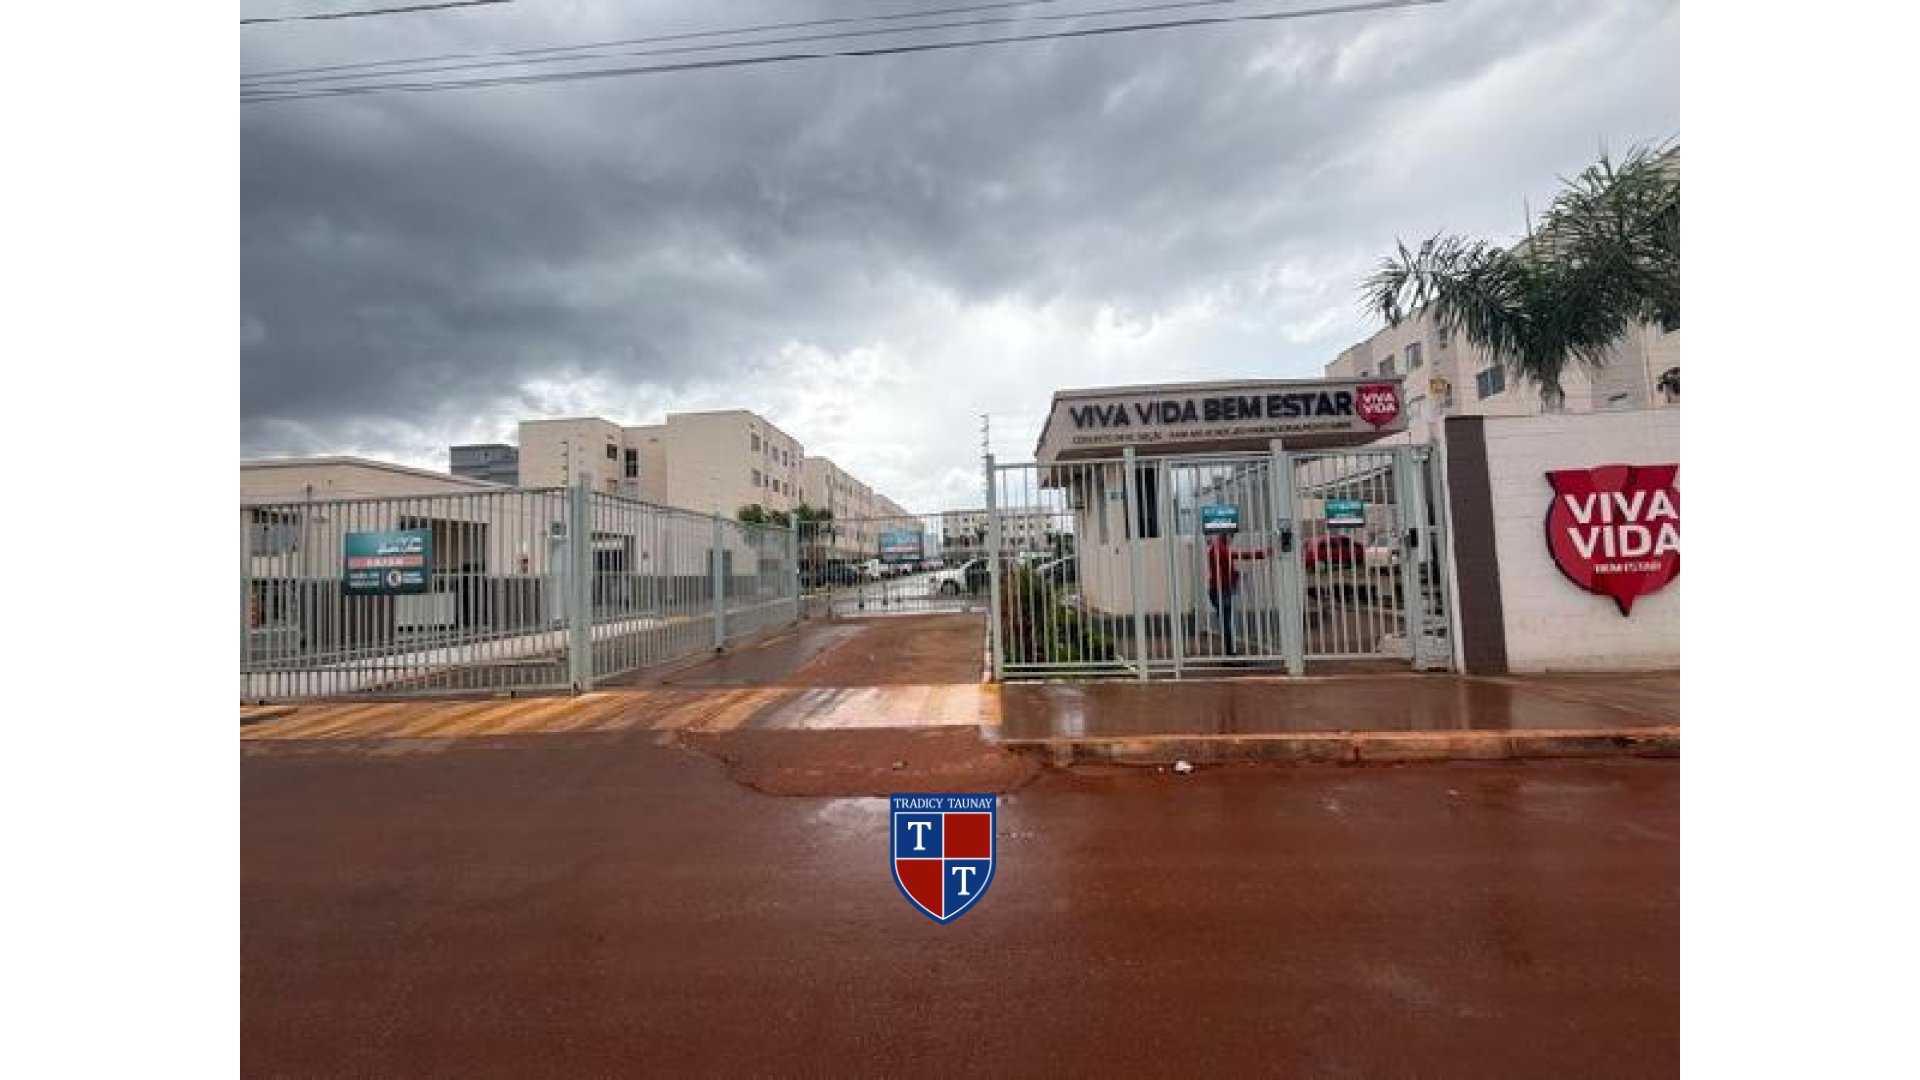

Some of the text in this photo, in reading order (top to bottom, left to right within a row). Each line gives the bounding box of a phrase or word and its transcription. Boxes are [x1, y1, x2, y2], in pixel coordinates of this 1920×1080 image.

[1069, 391, 1353, 429] VIVA VIDA BEM ESTAR
[1362, 393, 1395, 404] VIVA
[1362, 403, 1395, 413] VIDA
[1564, 489, 1679, 524] VIVA
[1566, 523, 1680, 559] VIDA
[1595, 562, 1622, 574] BEM
